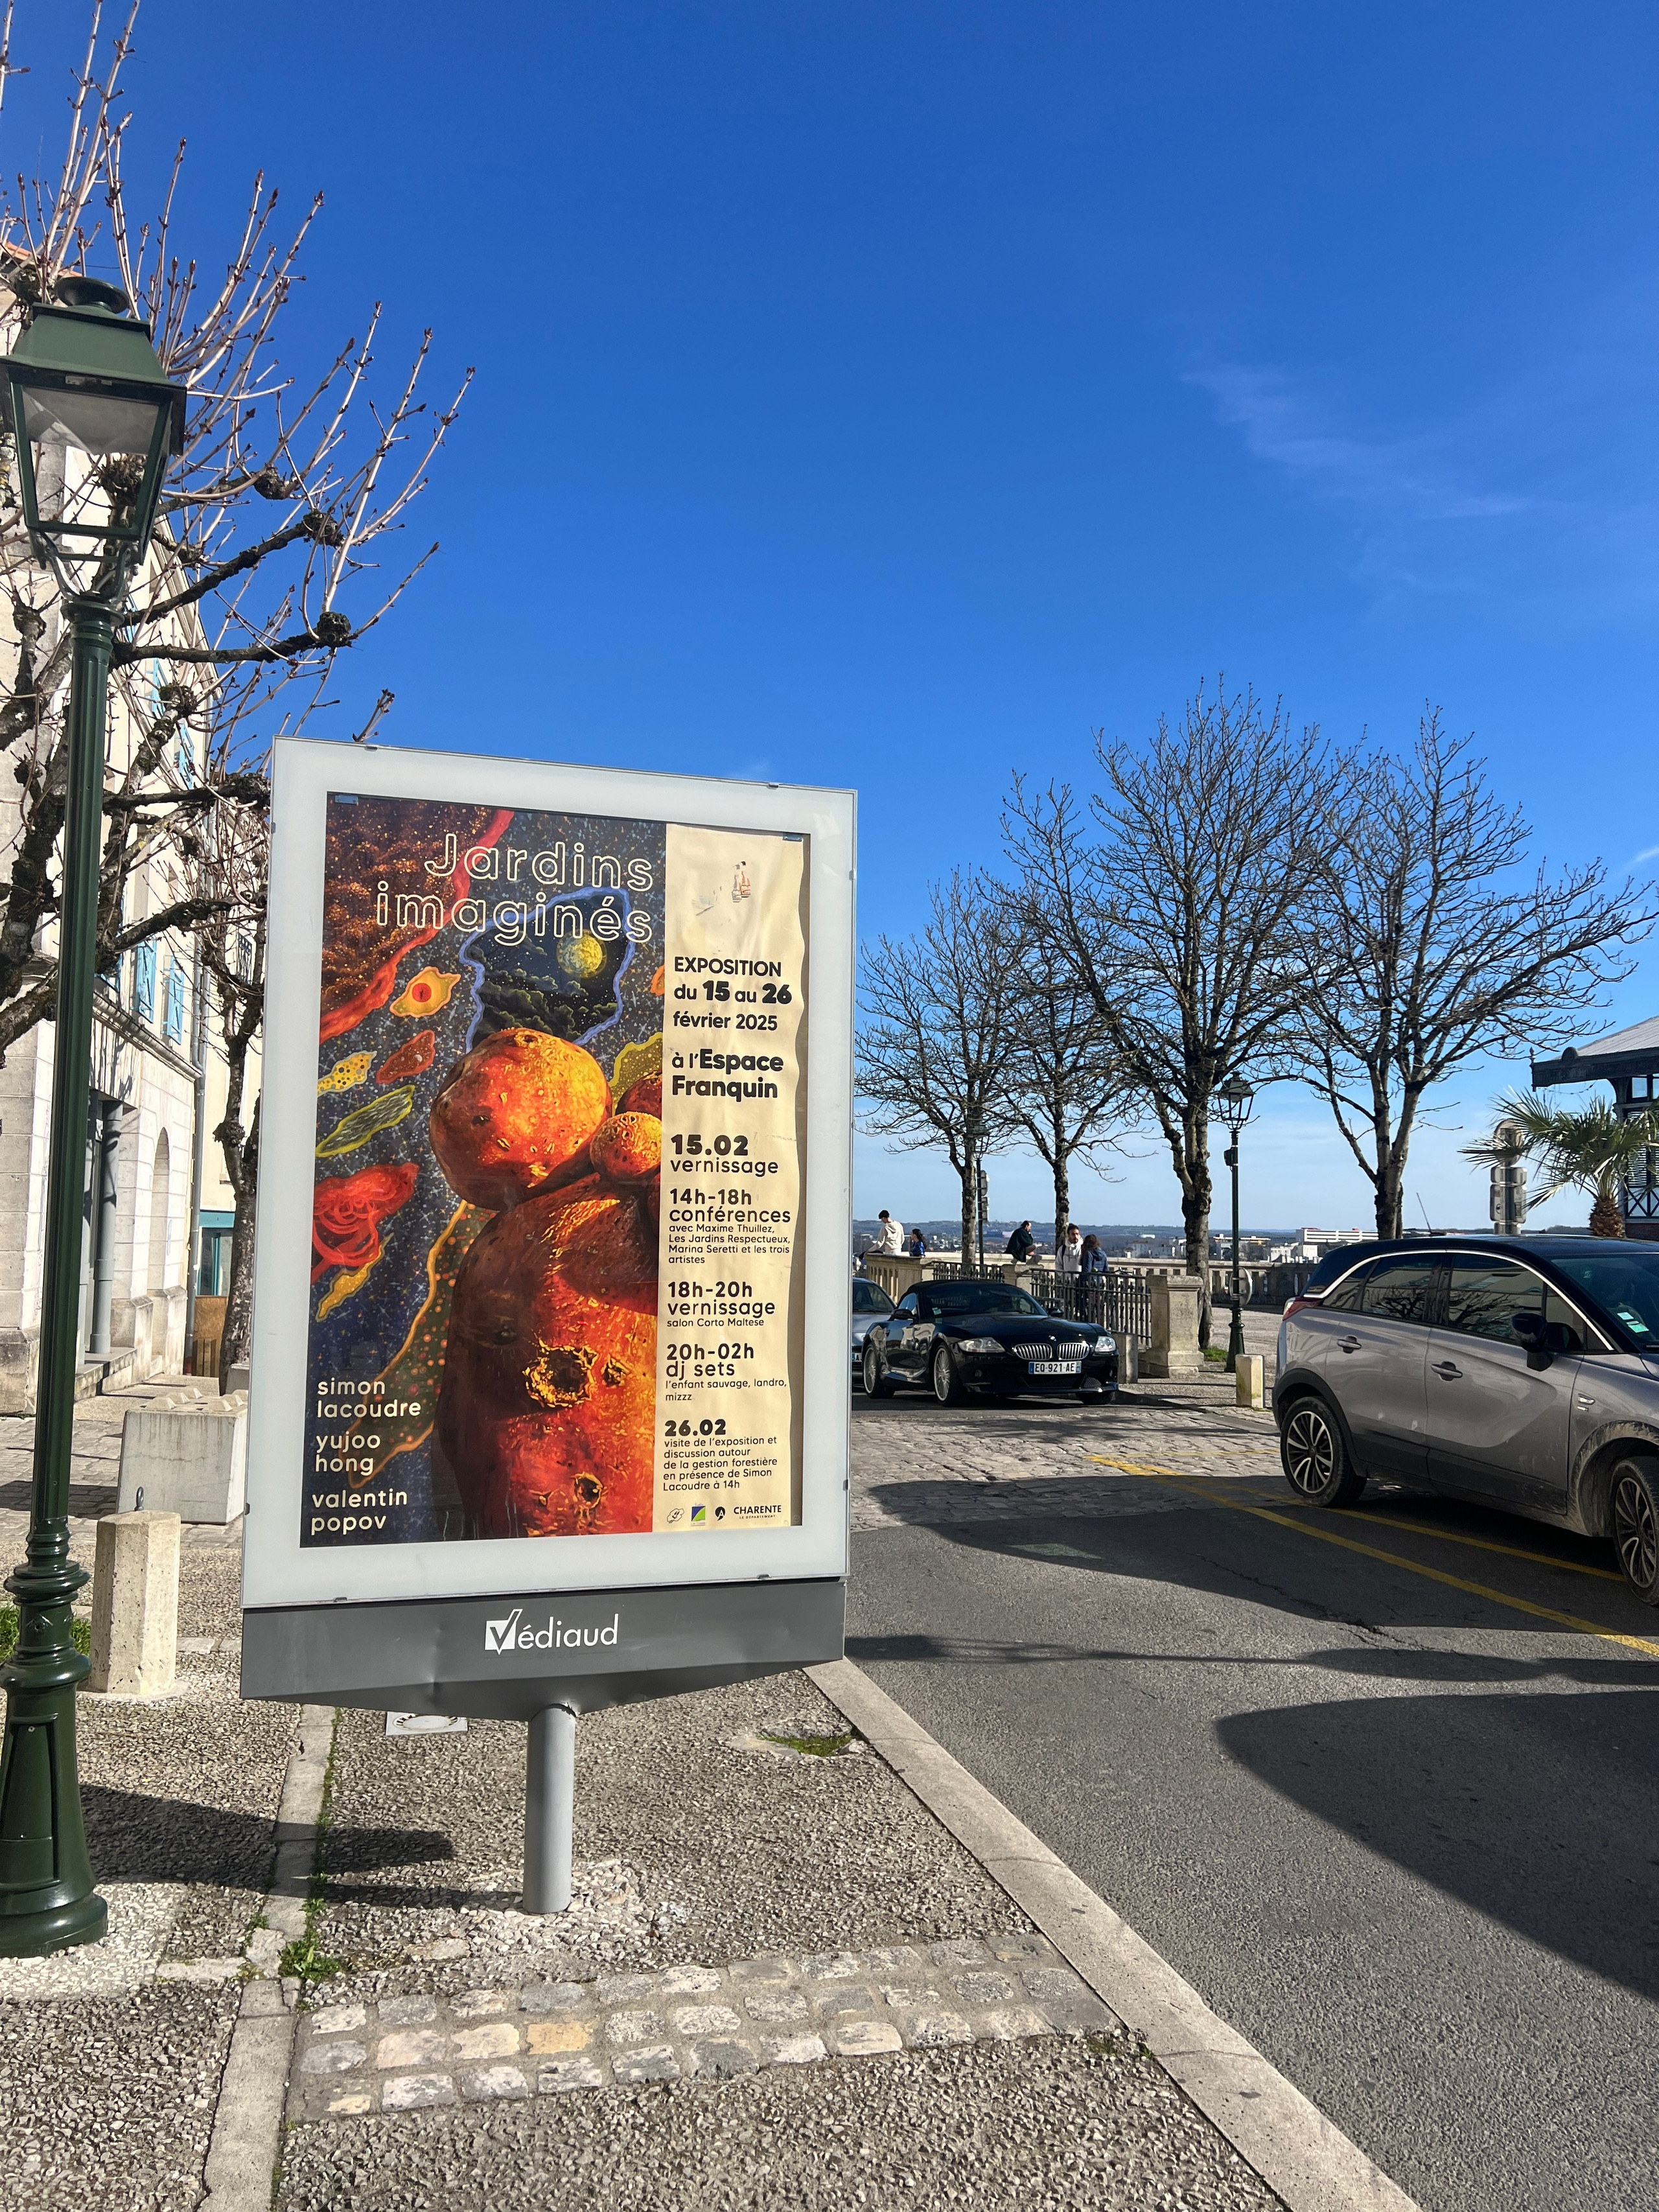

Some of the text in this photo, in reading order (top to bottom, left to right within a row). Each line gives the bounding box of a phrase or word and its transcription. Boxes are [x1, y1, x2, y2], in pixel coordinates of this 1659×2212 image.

[424, 833, 653, 892] Jardins
[377, 881, 653, 946] imaginés
[675, 957, 782, 977] EXPOSITION
[674, 981, 792, 1005] du 15 au 26
[673, 1011, 778, 1030] février 2025
[671, 1052, 684, 1069] à
[673, 1075, 778, 1102] Franquin
[671, 1134, 748, 1156] 15.02
[671, 1158, 778, 1177] vernissage
[670, 1188, 752, 1205] 14h-18h
[669, 1206, 791, 1222] conférences
[737, 1225, 774, 1233] Thuillez,
[728, 1235, 790, 1244] Respectueux,
[668, 1281, 752, 1298] 18h-20h
[667, 1299, 775, 1318] vernissage
[697, 1318, 725, 1327] Corto
[666, 1343, 754, 1360] 20h-02h
[666, 1361, 735, 1380] dj sets
[318, 1377, 386, 1395] simon
[707, 1380, 750, 1389] sauvage,
[754, 1379, 787, 1388] landro,
[666, 1392, 692, 1401] mizzz
[317, 1399, 421, 1418] lacoudre
[665, 1419, 726, 1436] 26.02
[316, 1431, 380, 1453] yujoo
[664, 1449, 715, 1458] discussion
[316, 1454, 374, 1476] hong
[664, 1461, 677, 1469] de
[693, 1460, 728, 1470] gestion
[732, 1457, 777, 1467] forestière
[679, 1470, 725, 1481] présence
[743, 1469, 772, 1477] Simon
[663, 1480, 739, 1491] Lacoudre à 14h
[312, 1488, 407, 1508] valentin
[734, 1505, 782, 1514] CHARENTE
[311, 1515, 386, 1535] popov
[485, 1609, 618, 1655] Védiaud
